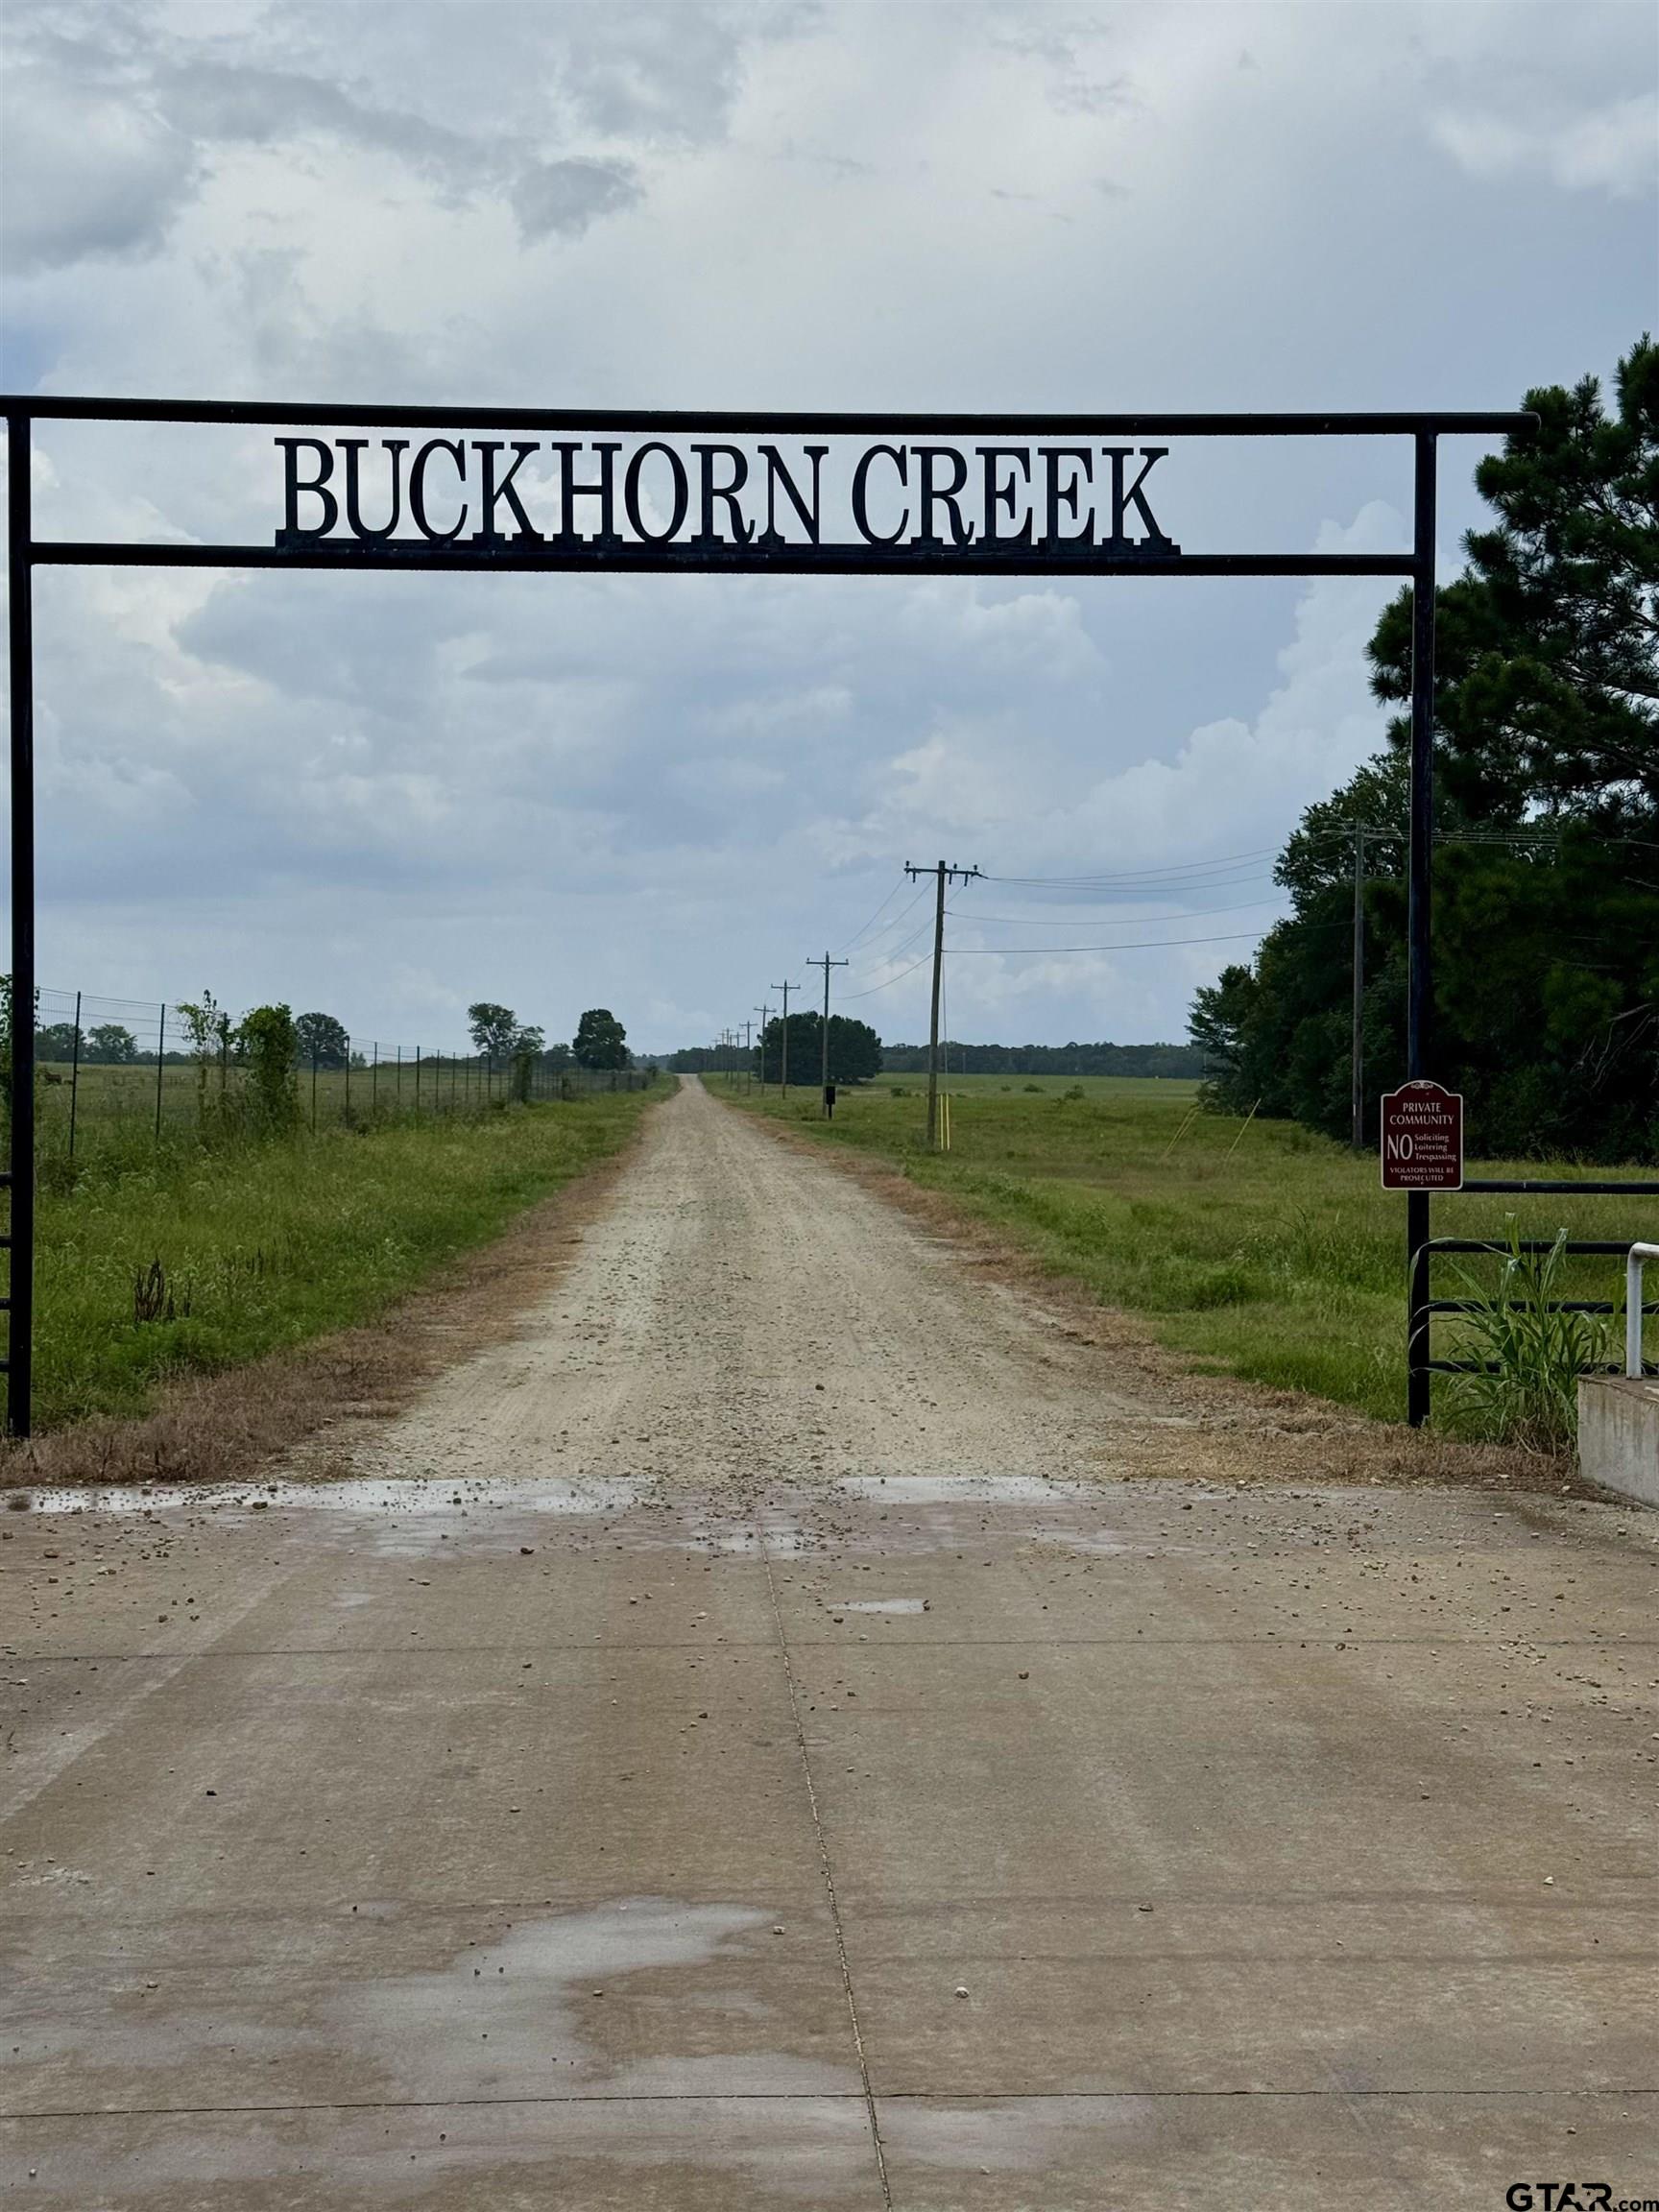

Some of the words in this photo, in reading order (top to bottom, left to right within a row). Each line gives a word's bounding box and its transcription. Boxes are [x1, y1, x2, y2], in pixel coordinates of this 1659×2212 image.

[275, 438, 829, 546] BUCKHORN
[852, 445, 1173, 547] CREEK
[1403, 1102, 1441, 1113] PRIVATE
[1389, 1115, 1455, 1125] COMMUNITY
[1414, 1133, 1450, 1142] Soliciting
[1387, 1134, 1413, 1160] NO
[1414, 1143, 1448, 1152] Loitering
[1415, 1153, 1456, 1162] Trespassing
